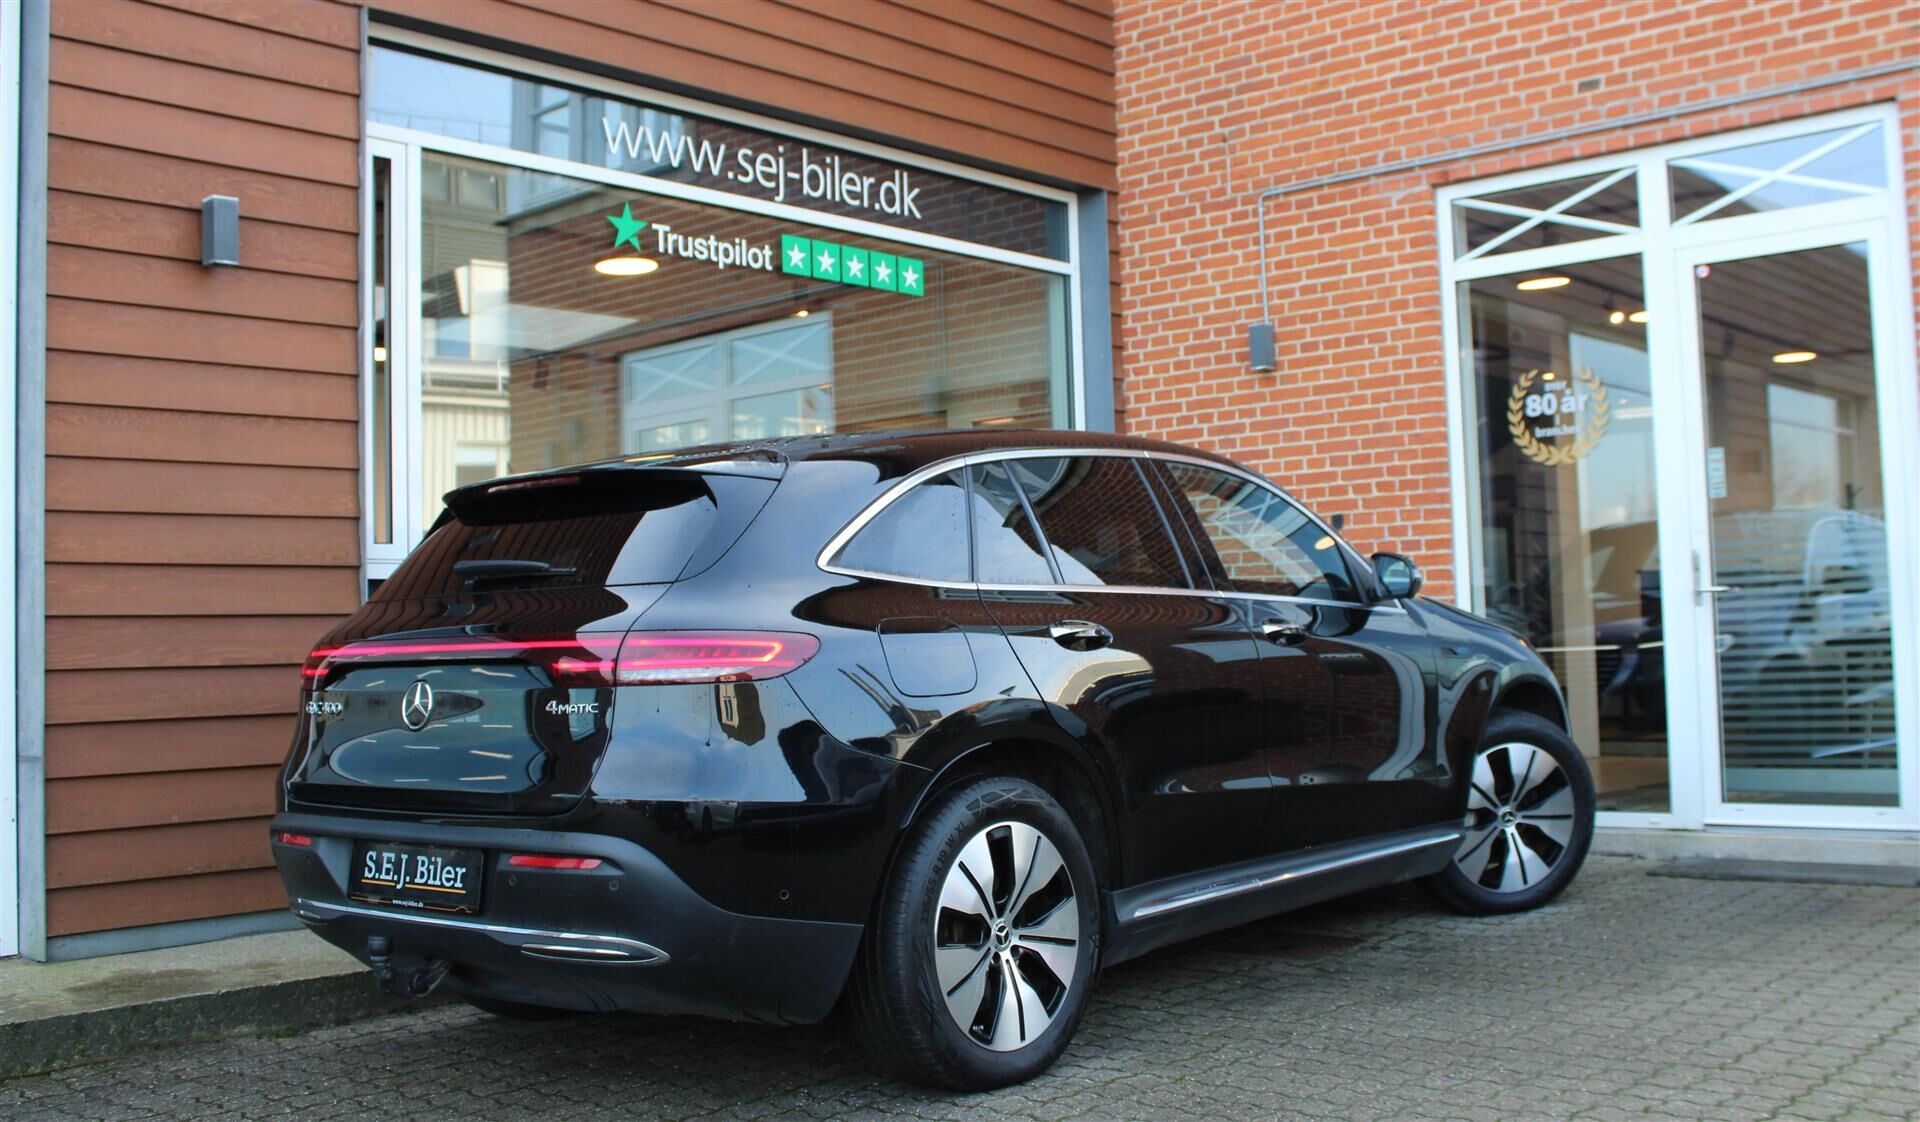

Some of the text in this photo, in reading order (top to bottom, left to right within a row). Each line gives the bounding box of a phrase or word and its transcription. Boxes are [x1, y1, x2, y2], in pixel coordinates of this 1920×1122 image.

[602, 116, 922, 219] www.sej-biler.dk
[651, 223, 773, 271] Trustpilot
[1525, 388, 1588, 417] 80 år
[545, 700, 599, 715] 4MATIC
[364, 850, 466, 889] S.E.J. Biler
